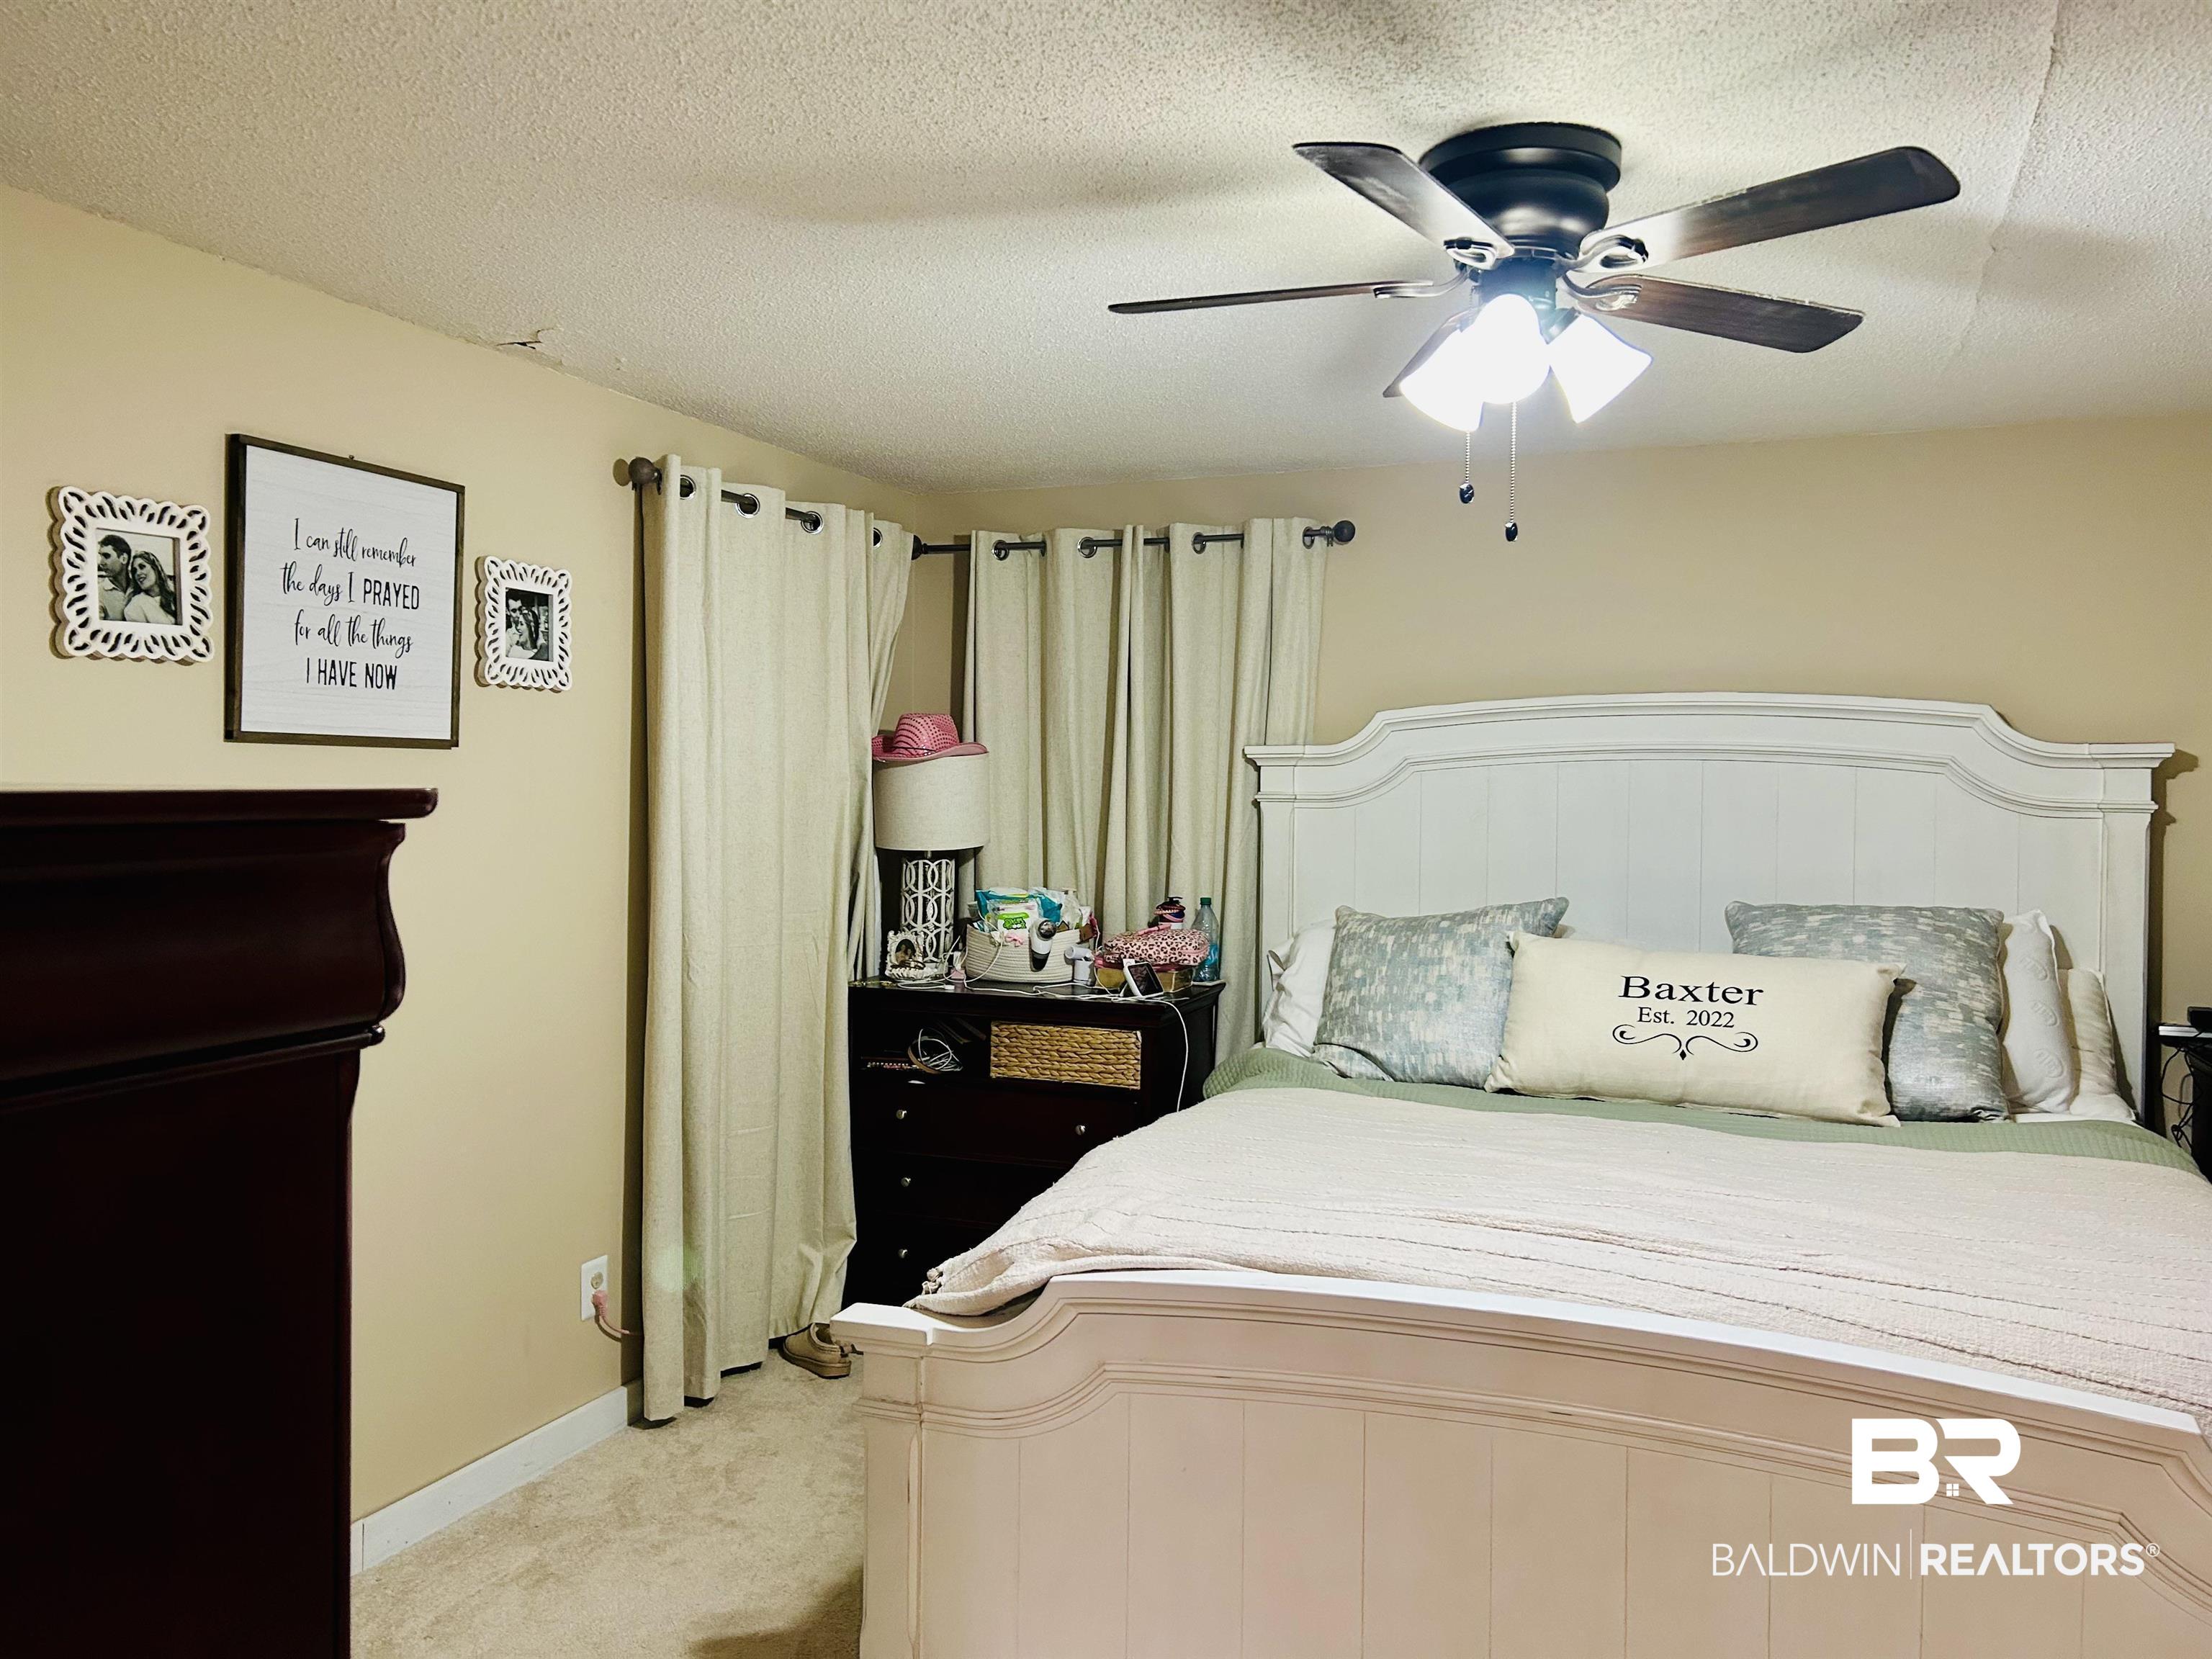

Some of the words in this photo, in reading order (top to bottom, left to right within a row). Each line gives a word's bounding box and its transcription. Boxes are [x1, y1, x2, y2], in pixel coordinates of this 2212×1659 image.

[293, 517, 301, 551] I
[306, 534, 331, 552] can
[333, 526, 359, 562] still
[360, 537, 417, 569] remember
[279, 560, 305, 595] the
[308, 563, 343, 607] days
[346, 571, 356, 603] I
[362, 577, 421, 611] PRAYED
[293, 608, 312, 646] for
[317, 612, 341, 649] all
[346, 614, 369, 649] the
[369, 616, 414, 660] things
[305, 657, 311, 685] I
[317, 657, 358, 688] HAVE
[364, 662, 398, 691] NOW
[1617, 975, 1765, 1007] Baxter
[1637, 1005, 1676, 1025] Est.
[1686, 1009, 1736, 1029] 2022
